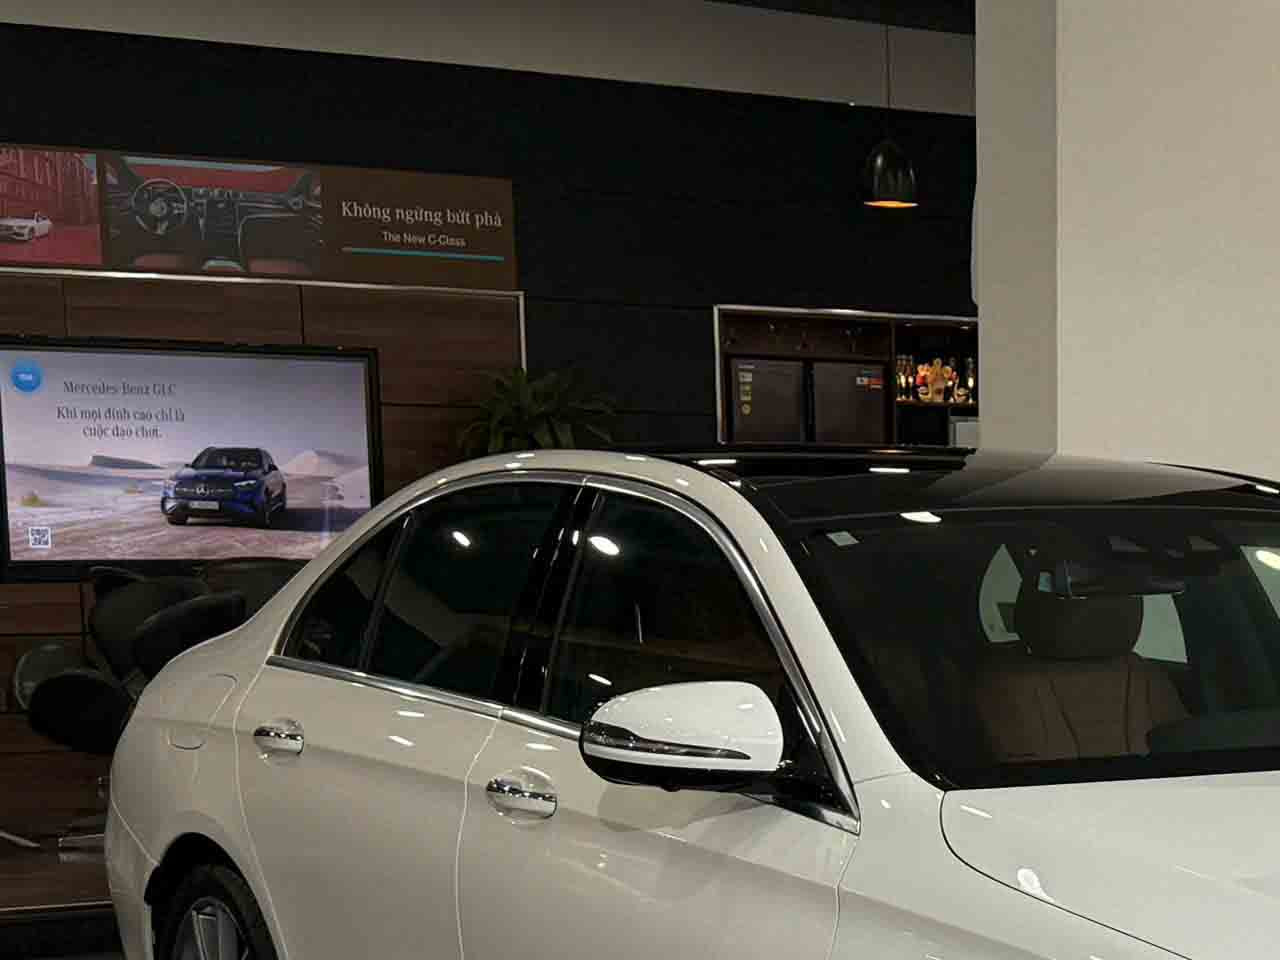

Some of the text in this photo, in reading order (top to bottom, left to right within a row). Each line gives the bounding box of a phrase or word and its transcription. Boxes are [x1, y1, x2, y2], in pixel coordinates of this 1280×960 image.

[383, 231, 467, 248] The New C-Class
[152, 383, 177, 396] GLC
[56, 406, 78, 420] Khi
[133, 411, 153, 423] cao
